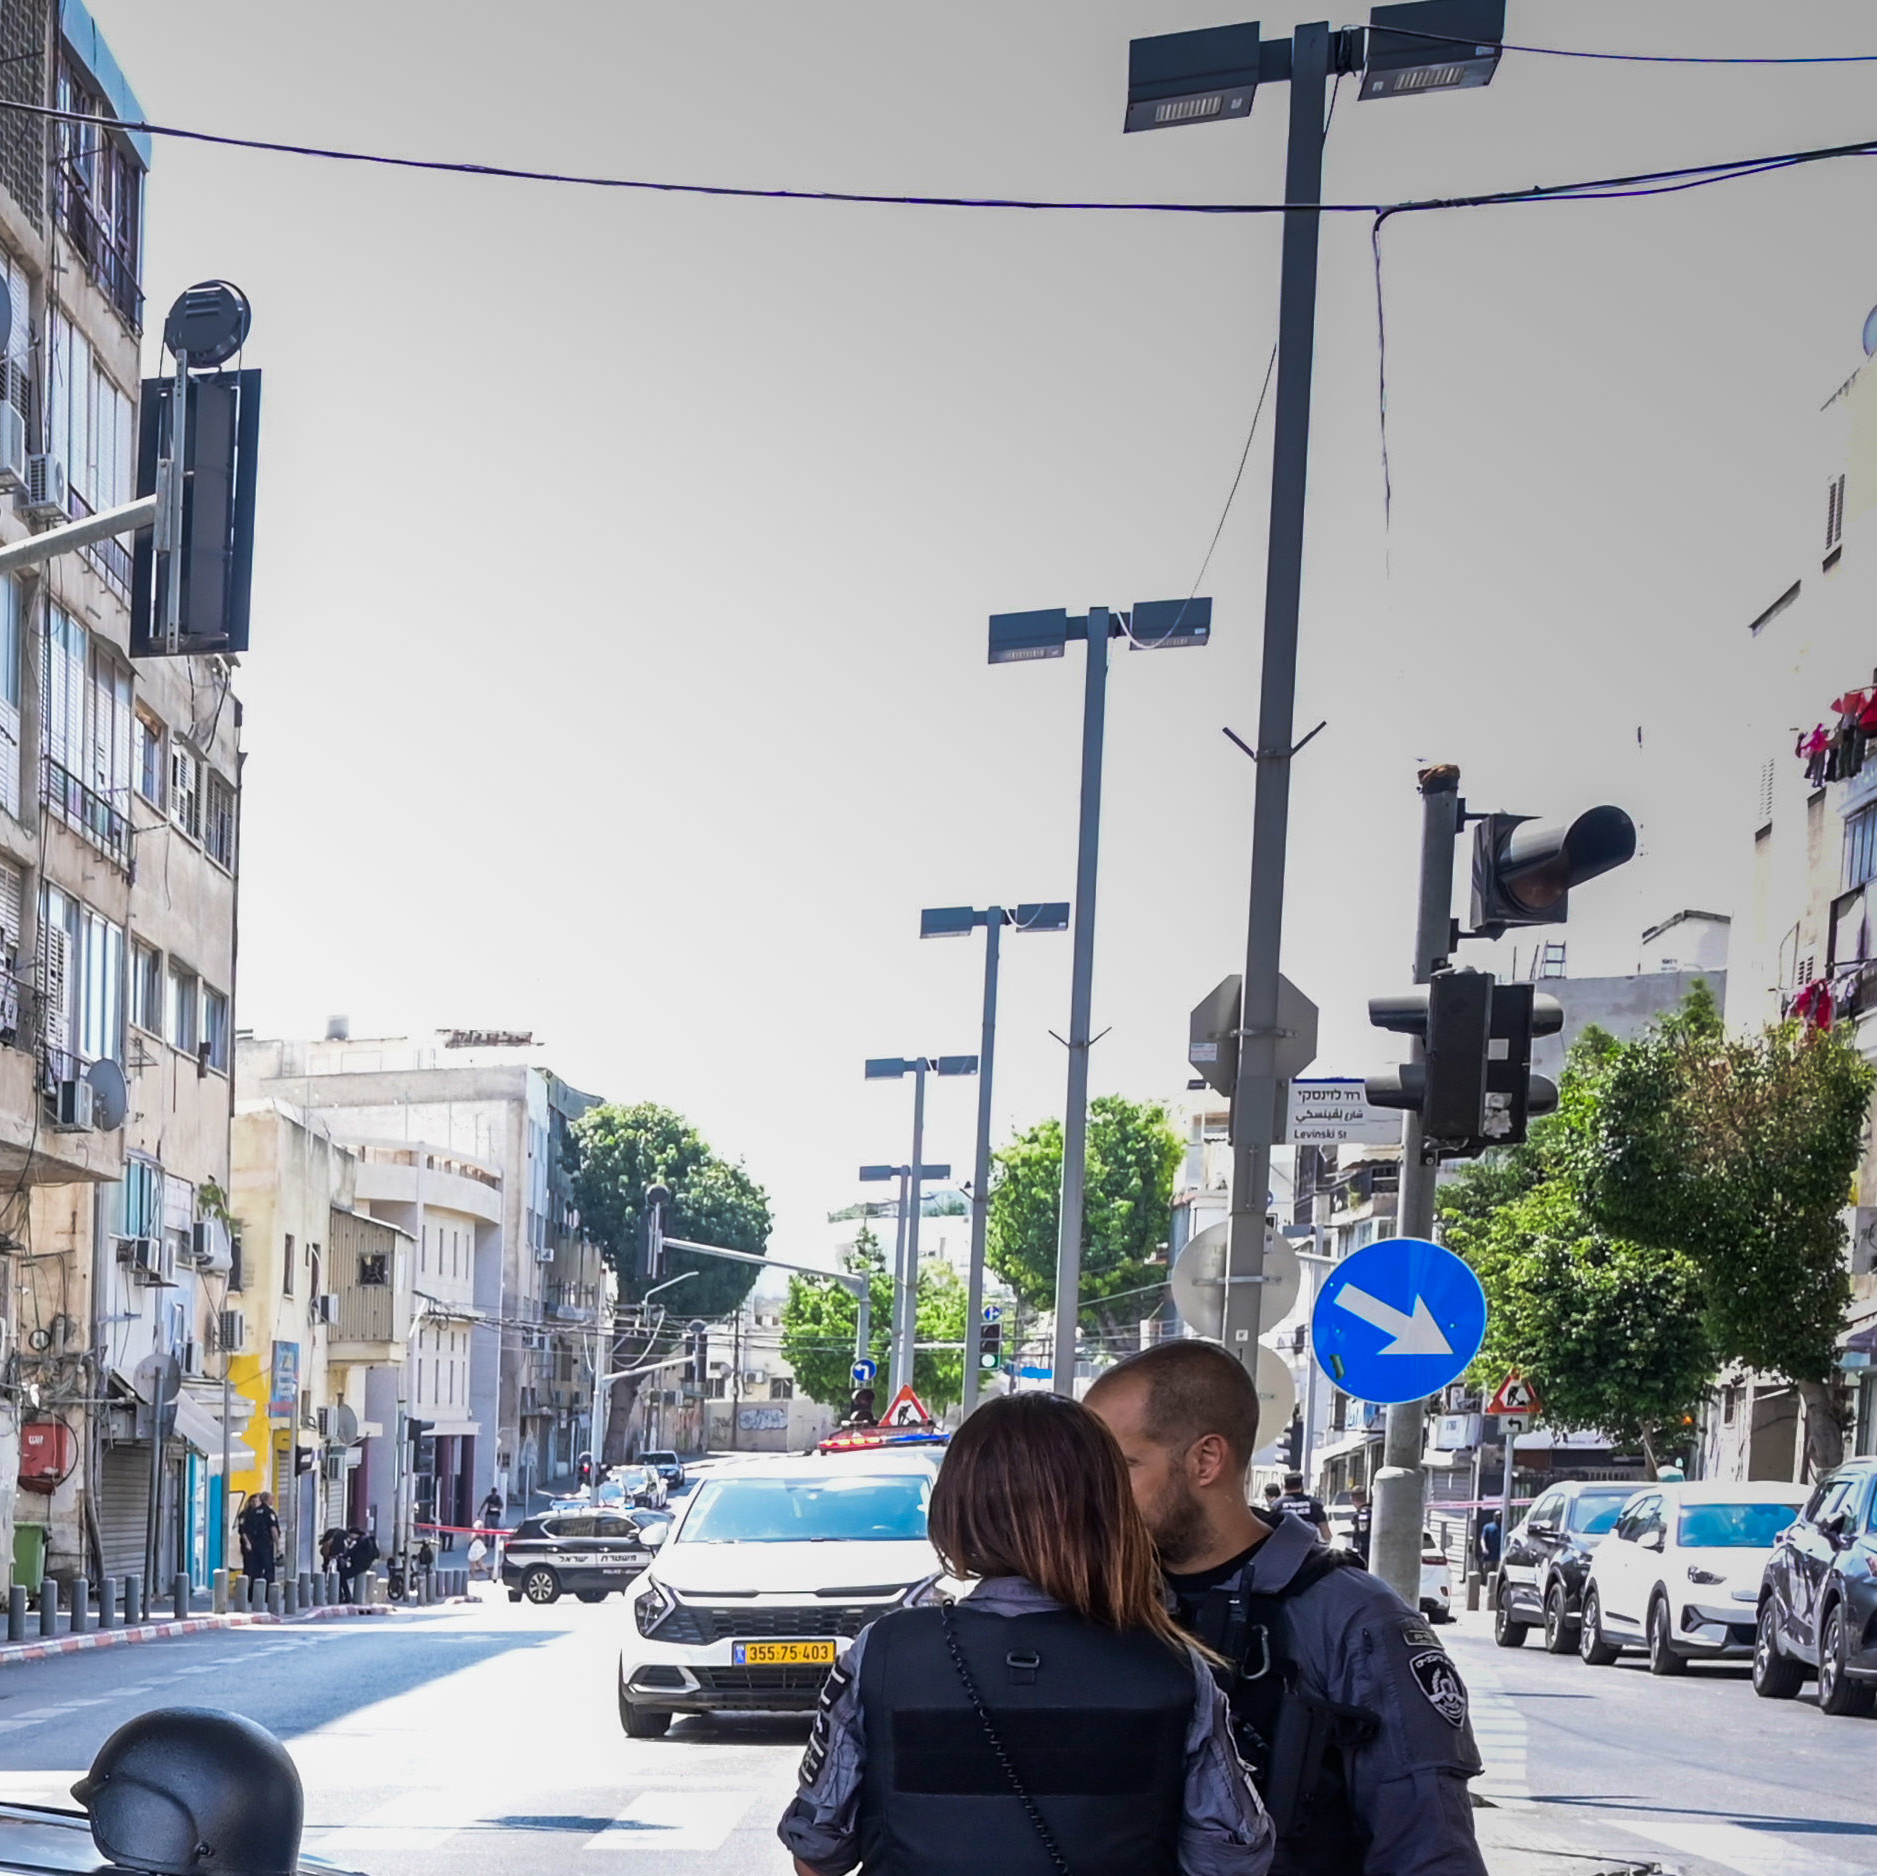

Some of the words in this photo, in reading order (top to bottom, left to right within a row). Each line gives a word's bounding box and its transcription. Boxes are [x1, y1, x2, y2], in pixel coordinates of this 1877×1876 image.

[1298, 1088, 1342, 1103] לוינסקי
[1294, 1129, 1335, 1139] Levinski
[559, 1555, 589, 1563] ישראל
[600, 1554, 638, 1563] משטרת
